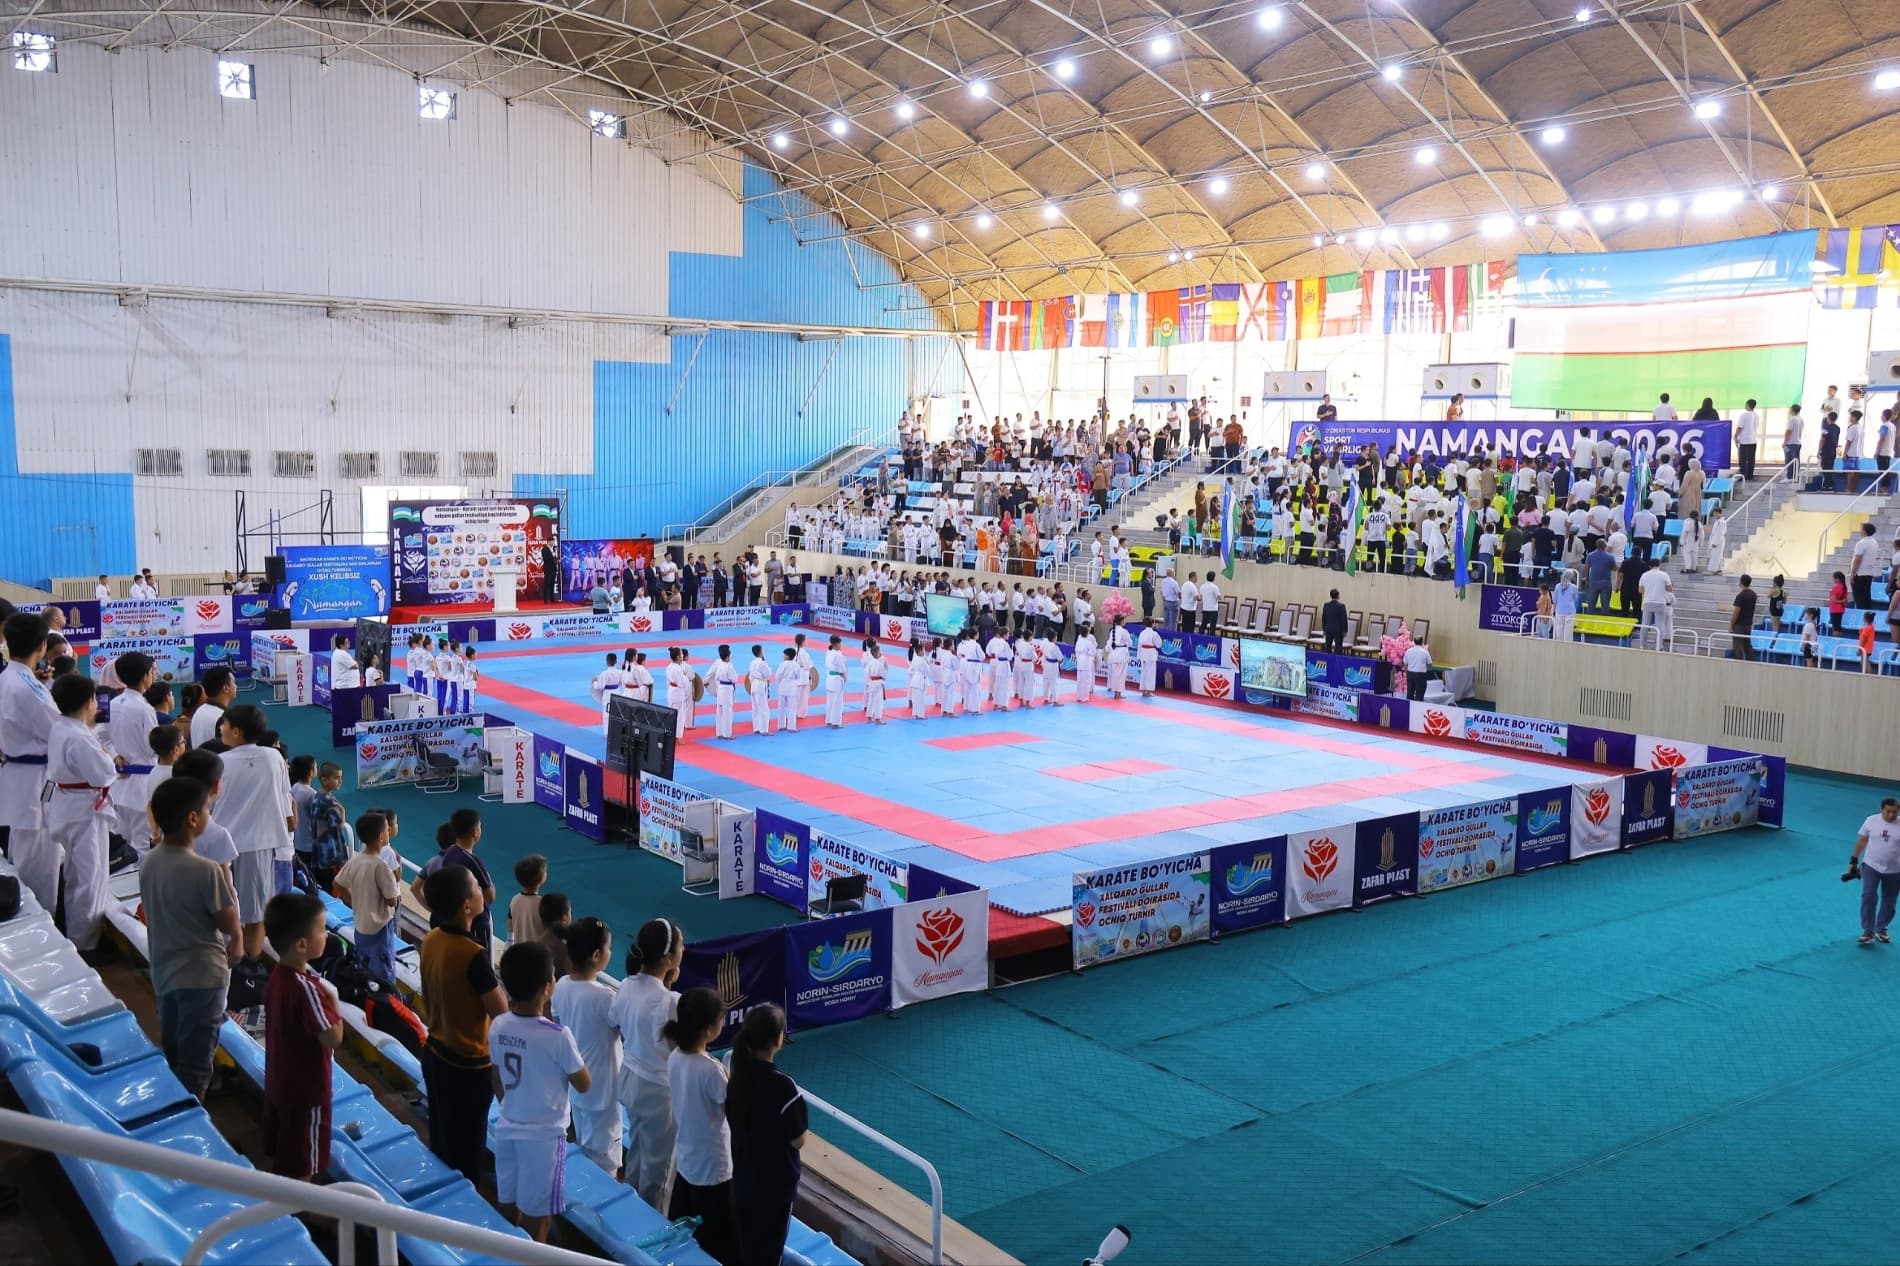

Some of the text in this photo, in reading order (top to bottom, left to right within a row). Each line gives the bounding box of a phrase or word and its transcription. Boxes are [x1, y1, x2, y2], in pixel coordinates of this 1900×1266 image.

[1323, 436, 1352, 444] SPORT
[1323, 445, 1362, 454] VARLIG
[393, 527, 402, 602] KARATE
[106, 600, 178, 609] KARATE BO'YICHA
[302, 598, 362, 615] Namangan
[710, 609, 735, 617] KARATE
[403, 625, 442, 634] BO'YICHA
[549, 618, 577, 626] KARATE
[1491, 614, 1529, 626] ZIYOKOR
[76, 627, 96, 635] PLAST
[99, 638, 186, 649] KARATE BO'YICHA
[296, 659, 305, 703] KARATE
[367, 717, 474, 735] KARATE BO'YICHA
[1473, 713, 1560, 735] KARATE BO'YICHA
[380, 739, 455, 753] FESTIVAL RASIDA
[380, 752, 404, 761] OCHIQ
[515, 741, 525, 799] KARATE
[1684, 761, 1757, 781] KARATE BO'YICHA
[645, 778, 671, 797] KARATE
[568, 803, 598, 825] ZAFAR PLAST
[1427, 801, 1511, 826] KARATE BO'YICHA
[1628, 816, 1666, 834] ZAFAR PLAST
[733, 821, 744, 892] KARATE
[816, 835, 898, 879] KARATE BO'YICHA
[1435, 847, 1456, 858] OCHIQ
[1086, 857, 1202, 890] KARATE BO'YICHA
[1361, 874, 1385, 890] ZAFAR
[1100, 881, 1169, 902] XALQARO GULLAR
[1218, 891, 1278, 910] NORIN-SIRDARYO
[1098, 891, 1180, 914] FESTIVALI DOIRASIDA
[1098, 908, 1156, 927] OCHIQ TURNIR
[796, 975, 884, 1001] NORIN-SIRDARYO
[504, 1052, 522, 1090] 9
